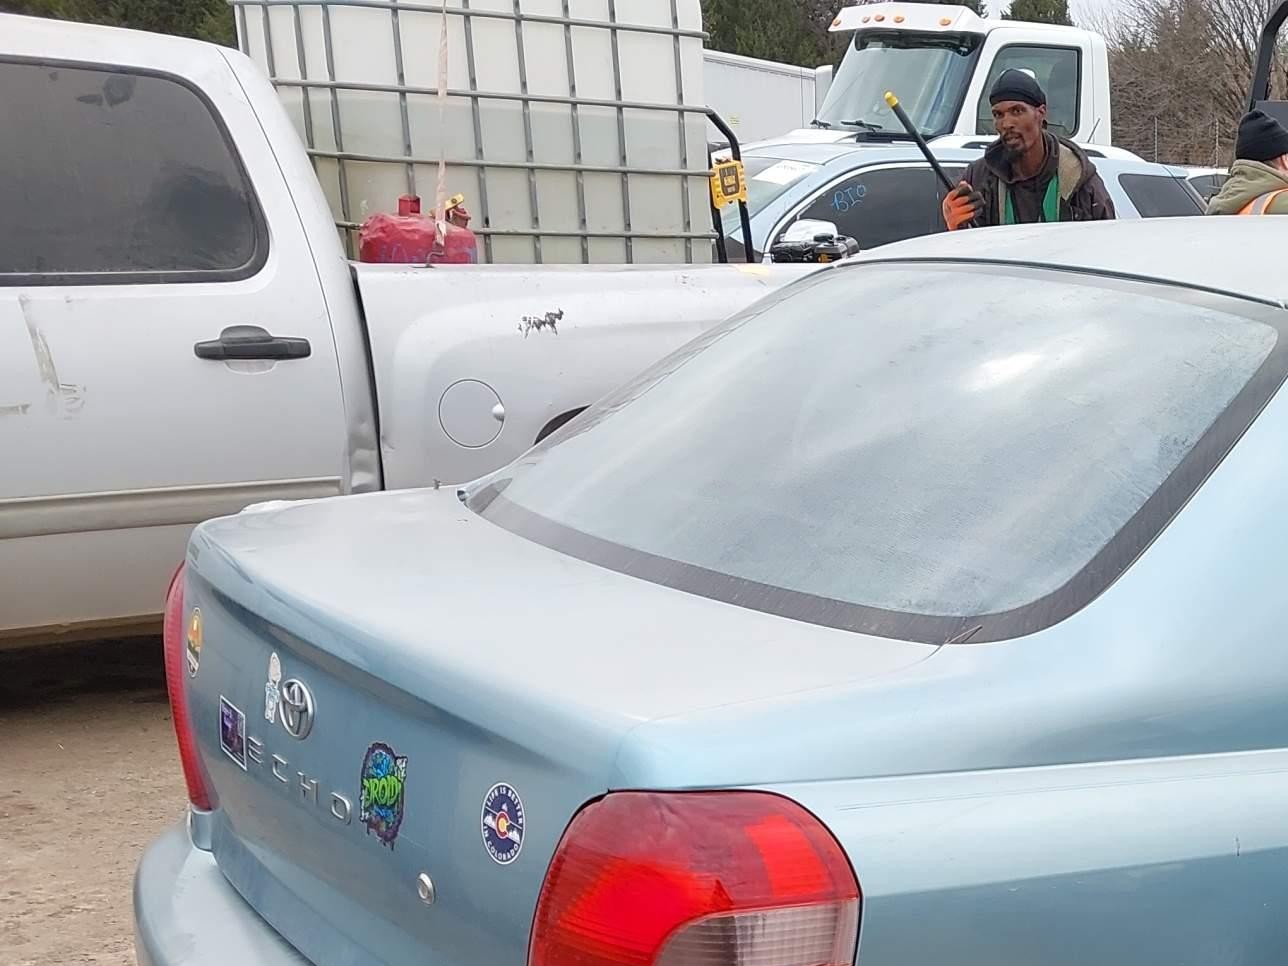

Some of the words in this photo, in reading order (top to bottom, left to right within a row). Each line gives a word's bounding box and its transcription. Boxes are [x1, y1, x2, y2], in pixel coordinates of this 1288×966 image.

[247, 736, 352, 825] ECHO
[486, 788, 499, 807] LIFE
[499, 786, 507, 795] IS
[507, 789, 523, 824] BETTER
[487, 841, 519, 861] COLORADO
